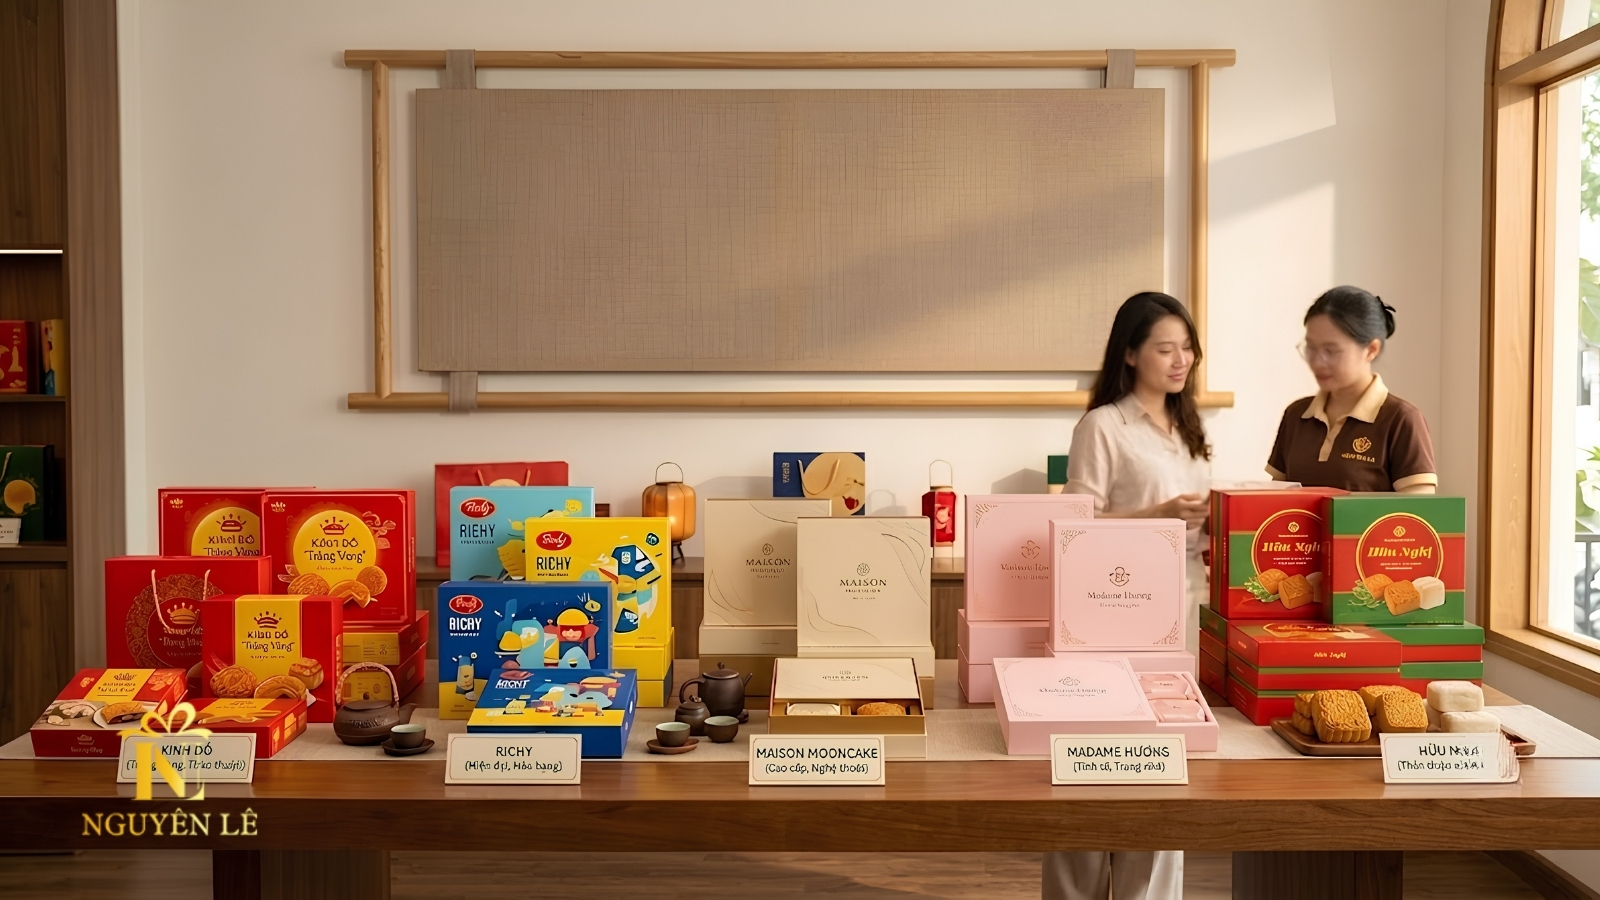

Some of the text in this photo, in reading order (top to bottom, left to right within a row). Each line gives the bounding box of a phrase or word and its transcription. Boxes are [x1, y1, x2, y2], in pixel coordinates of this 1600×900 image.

[536, 556, 572, 570] RICHY
[839, 579, 887, 587] MAISON
[161, 745, 190, 755] KINH
[496, 746, 533, 756] RICHY
[756, 748, 878, 758] MAISON MOONCAKE
[1067, 747, 1122, 757] MADAME
